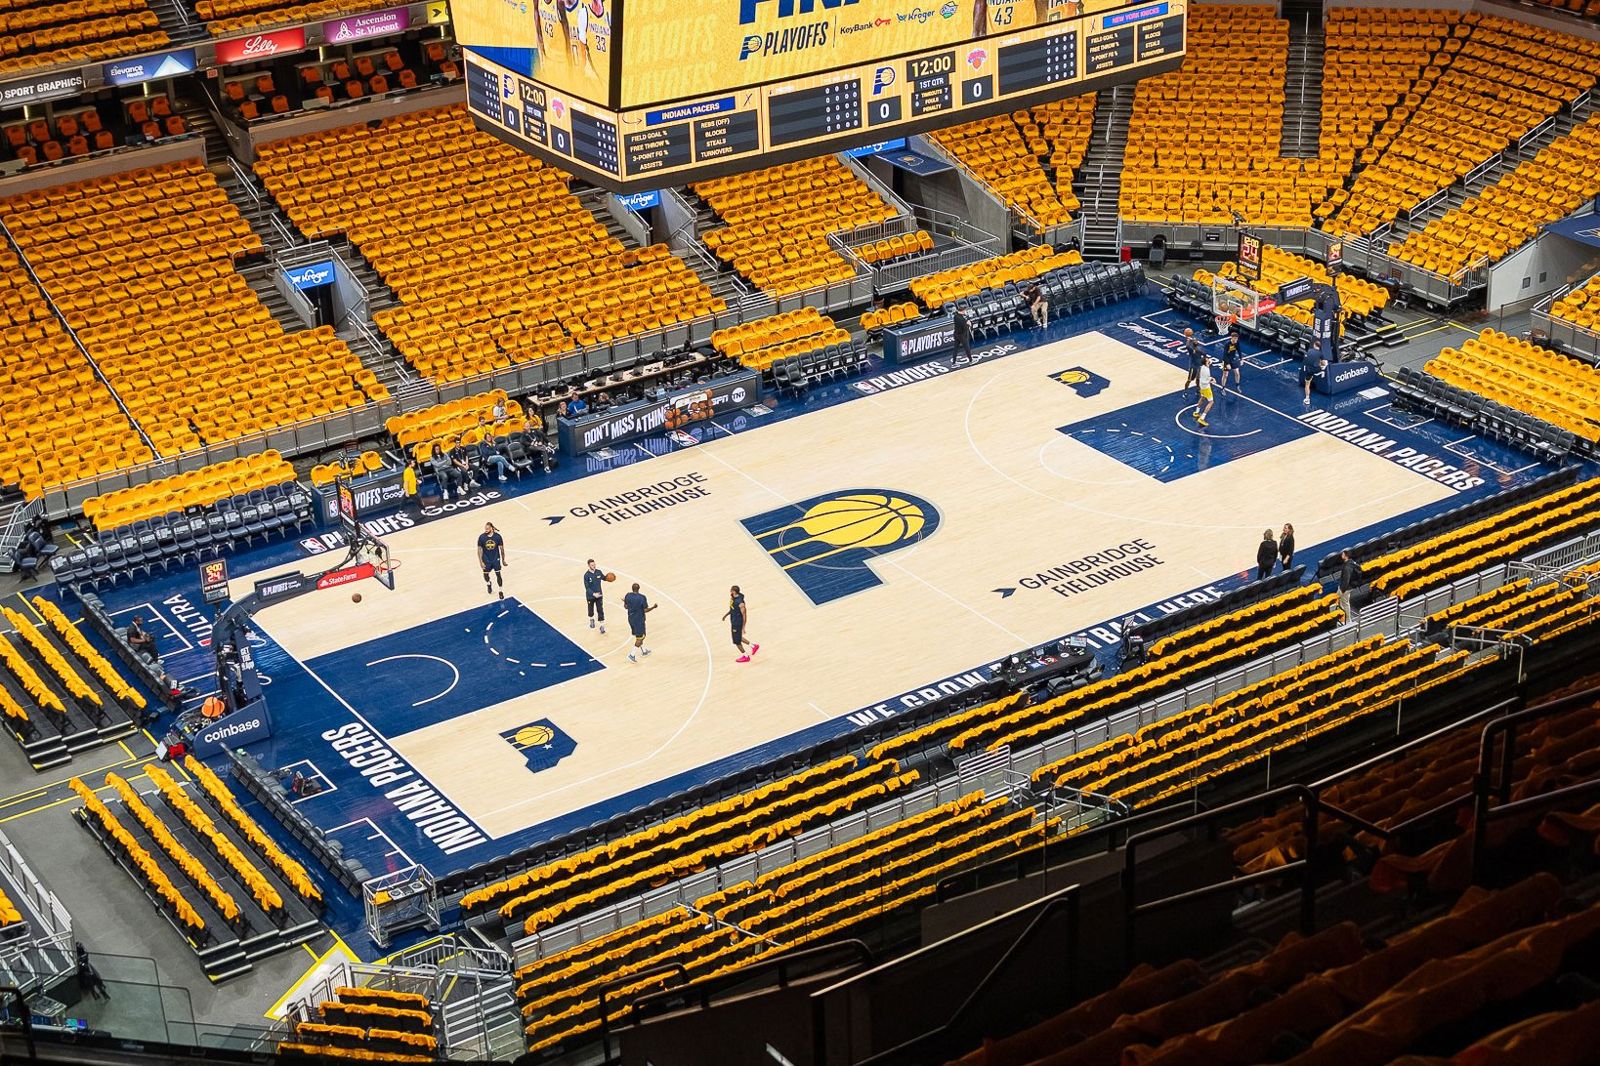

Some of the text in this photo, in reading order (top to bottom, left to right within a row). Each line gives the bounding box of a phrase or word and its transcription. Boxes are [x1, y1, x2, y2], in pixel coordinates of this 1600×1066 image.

[355, 13, 397, 27] Ascension
[908, 8, 935, 23] Kroger
[994, 7, 1013, 25] 43
[840, 22, 873, 34] KeyBank
[243, 36, 278, 55] Lilly
[595, 35, 607, 53] 33
[763, 21, 829, 57] PLAYOFFS
[912, 56, 951, 78] 12:00
[5, 77, 82, 99] SPORT GRAPHICS
[920, 78, 944, 89] 1ST QTR
[973, 82, 982, 98] 0
[520, 83, 545, 107] 12:00
[508, 110, 515, 126] 0
[662, 103, 719, 120] INDIANA PACERS
[880, 103, 890, 119] 0
[701, 117, 730, 128] REBS (OFF)
[557, 133, 565, 148] 0
[631, 134, 646, 142] FIELD
[705, 128, 726, 138] BLOCKS
[645, 142, 664, 150] THROW
[706, 138, 726, 147] STEALS
[633, 152, 655, 161] 3-POINT
[701, 147, 732, 158] TURNOVERS
[640, 161, 663, 170] ASSISTS
[630, 193, 655, 207] Kroger
[302, 269, 329, 284] Kroger
[908, 333, 943, 354] PLAYOFFS
[868, 361, 949, 391] PLAYOFFS
[1335, 366, 1369, 383] coinbase
[584, 421, 609, 447] DON'T
[611, 414, 635, 440] MISS
[636, 418, 642, 433] A
[1296, 409, 1486, 491] INDIANA PACERS
[354, 488, 381, 510] YOFFS
[421, 490, 501, 517] Google
[570, 471, 708, 518] GAINBRIDGE
[598, 485, 711, 525] FIELDHOUSE
[1019, 538, 1156, 589] GAINBRIDGE
[1051, 554, 1165, 597] FIELDHOUSE
[1156, 585, 1225, 614] HERE
[163, 594, 213, 638] ULTRA
[846, 704, 896, 727] WE
[204, 719, 260, 743] coinbase
[321, 722, 488, 856] INDIANA PACERS
